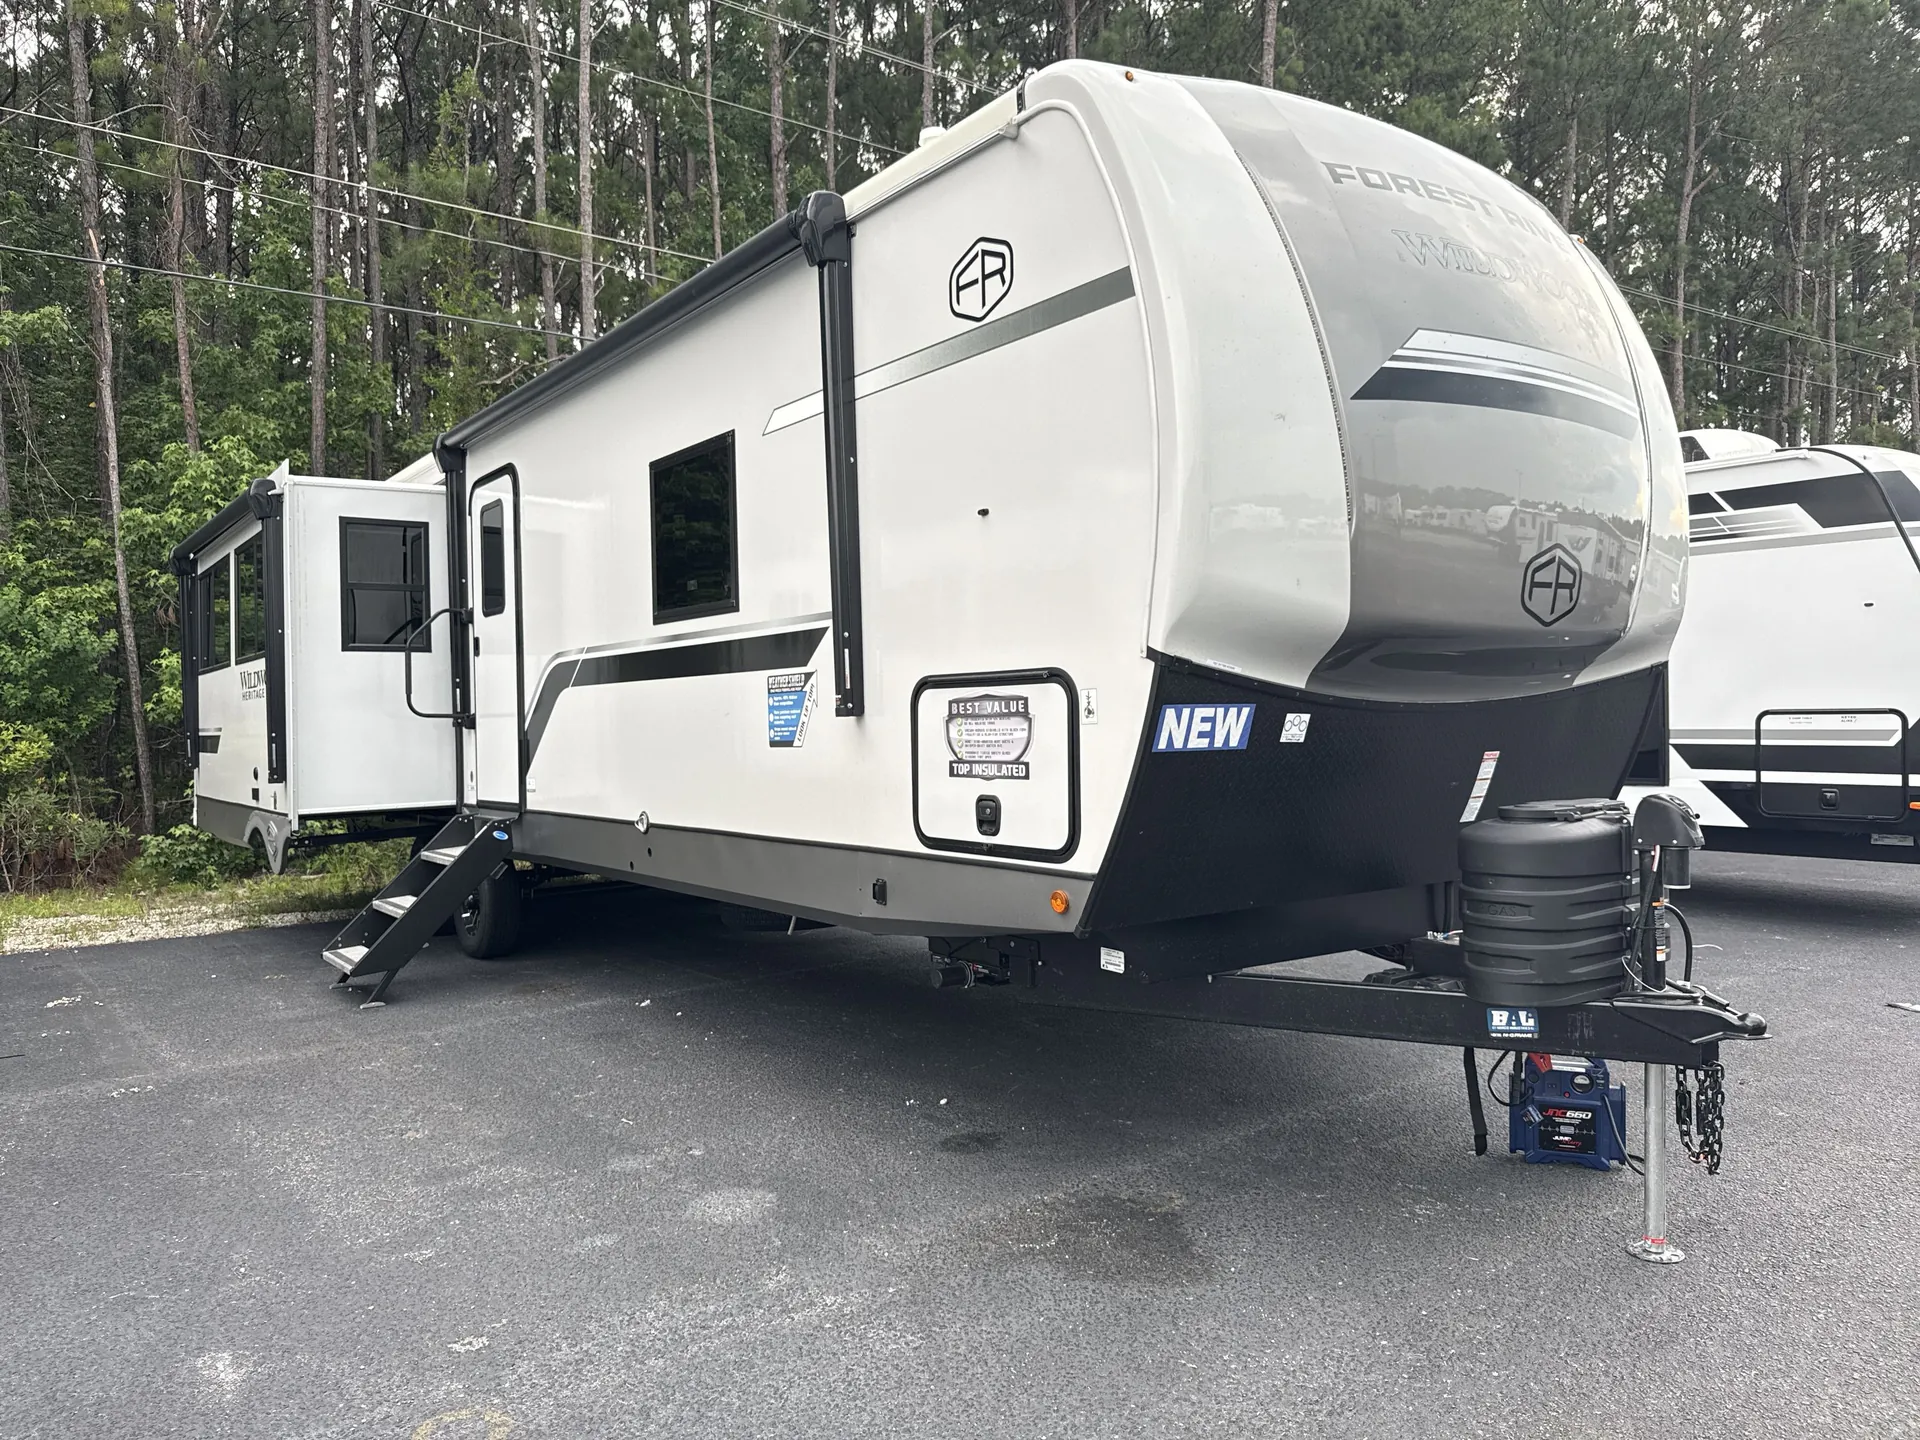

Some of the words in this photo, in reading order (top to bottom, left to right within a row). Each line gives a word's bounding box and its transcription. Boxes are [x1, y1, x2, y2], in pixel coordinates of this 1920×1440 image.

[1320, 161, 1494, 217] FOREST
[242, 688, 265, 701] HERITAGE
[951, 702, 979, 715] BEST
[986, 700, 1025, 714] VALUE
[1157, 707, 1251, 749] NEW
[952, 763, 970, 775] TOP
[972, 763, 1026, 777] INSULATED
[1487, 904, 1516, 916] GAS
[1491, 1010, 1535, 1027] BAL
[1542, 1108, 1592, 1120] JNC660
